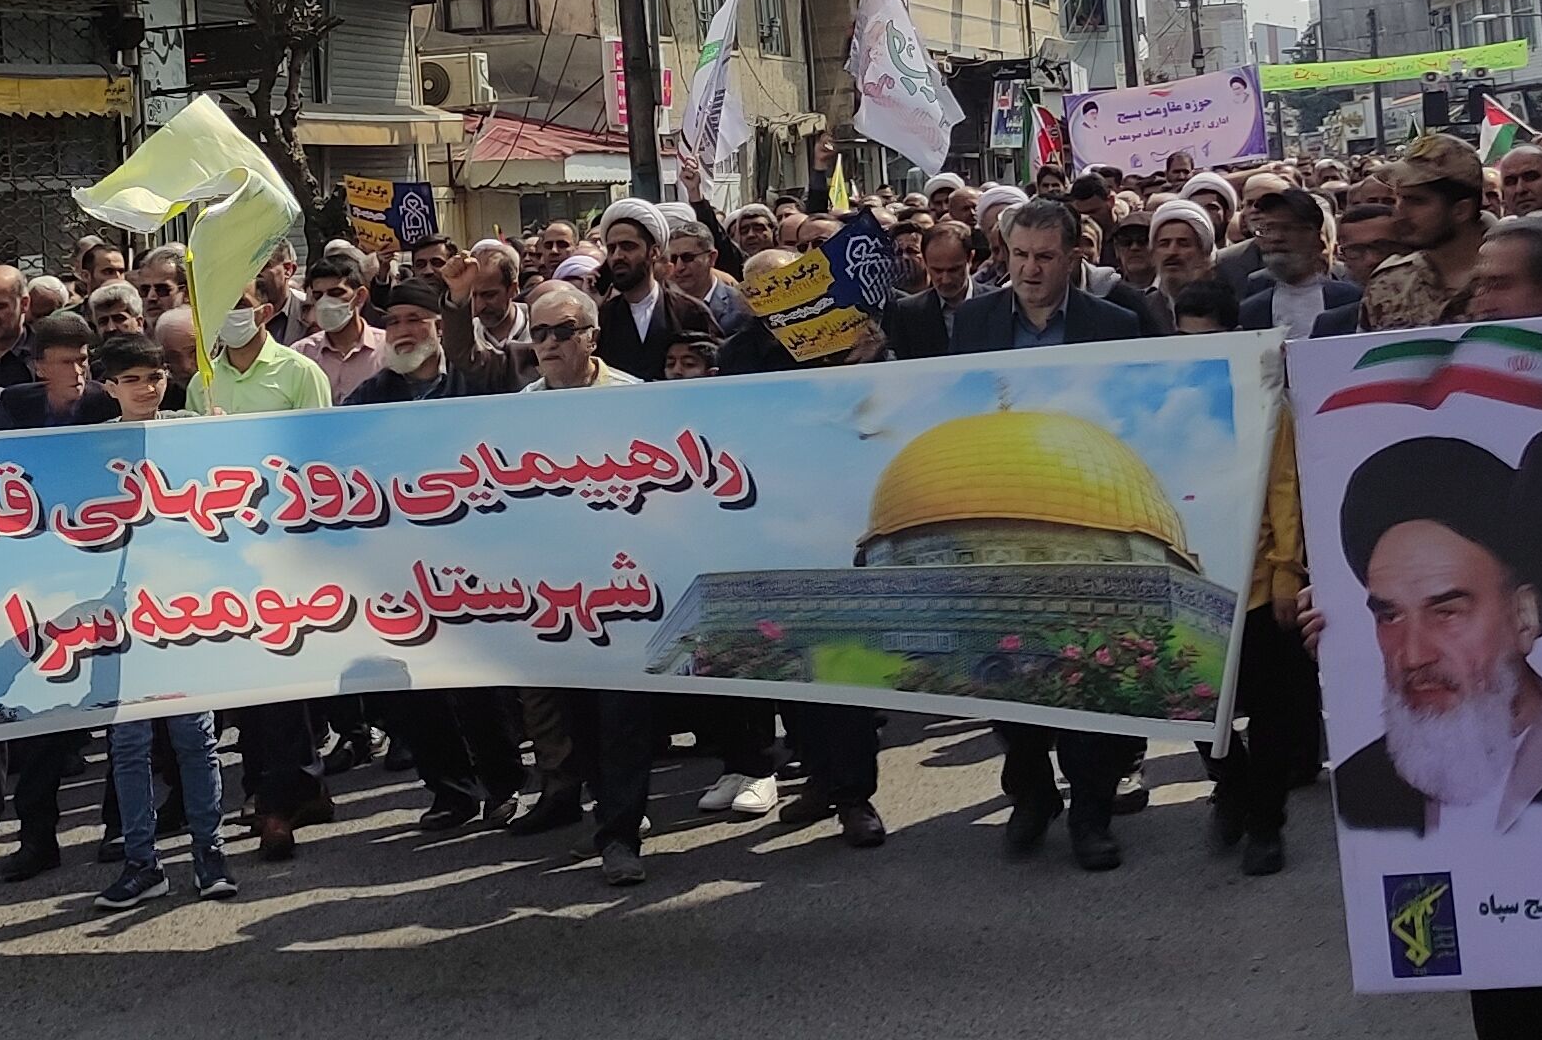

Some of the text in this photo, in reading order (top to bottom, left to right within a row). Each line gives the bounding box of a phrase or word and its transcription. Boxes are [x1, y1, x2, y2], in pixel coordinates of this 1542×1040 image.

[1117, 98, 1212, 124] حوزه مقاومت بسیج
[1174, 120, 1202, 136] کارگری
[51, 457, 267, 550] جهانی
[263, 455, 387, 531] روز
[390, 428, 753, 523] راهپیمایی
[4, 551, 662, 682] شهرستان صومعه سرا
[1479, 894, 1519, 923] سپاه
